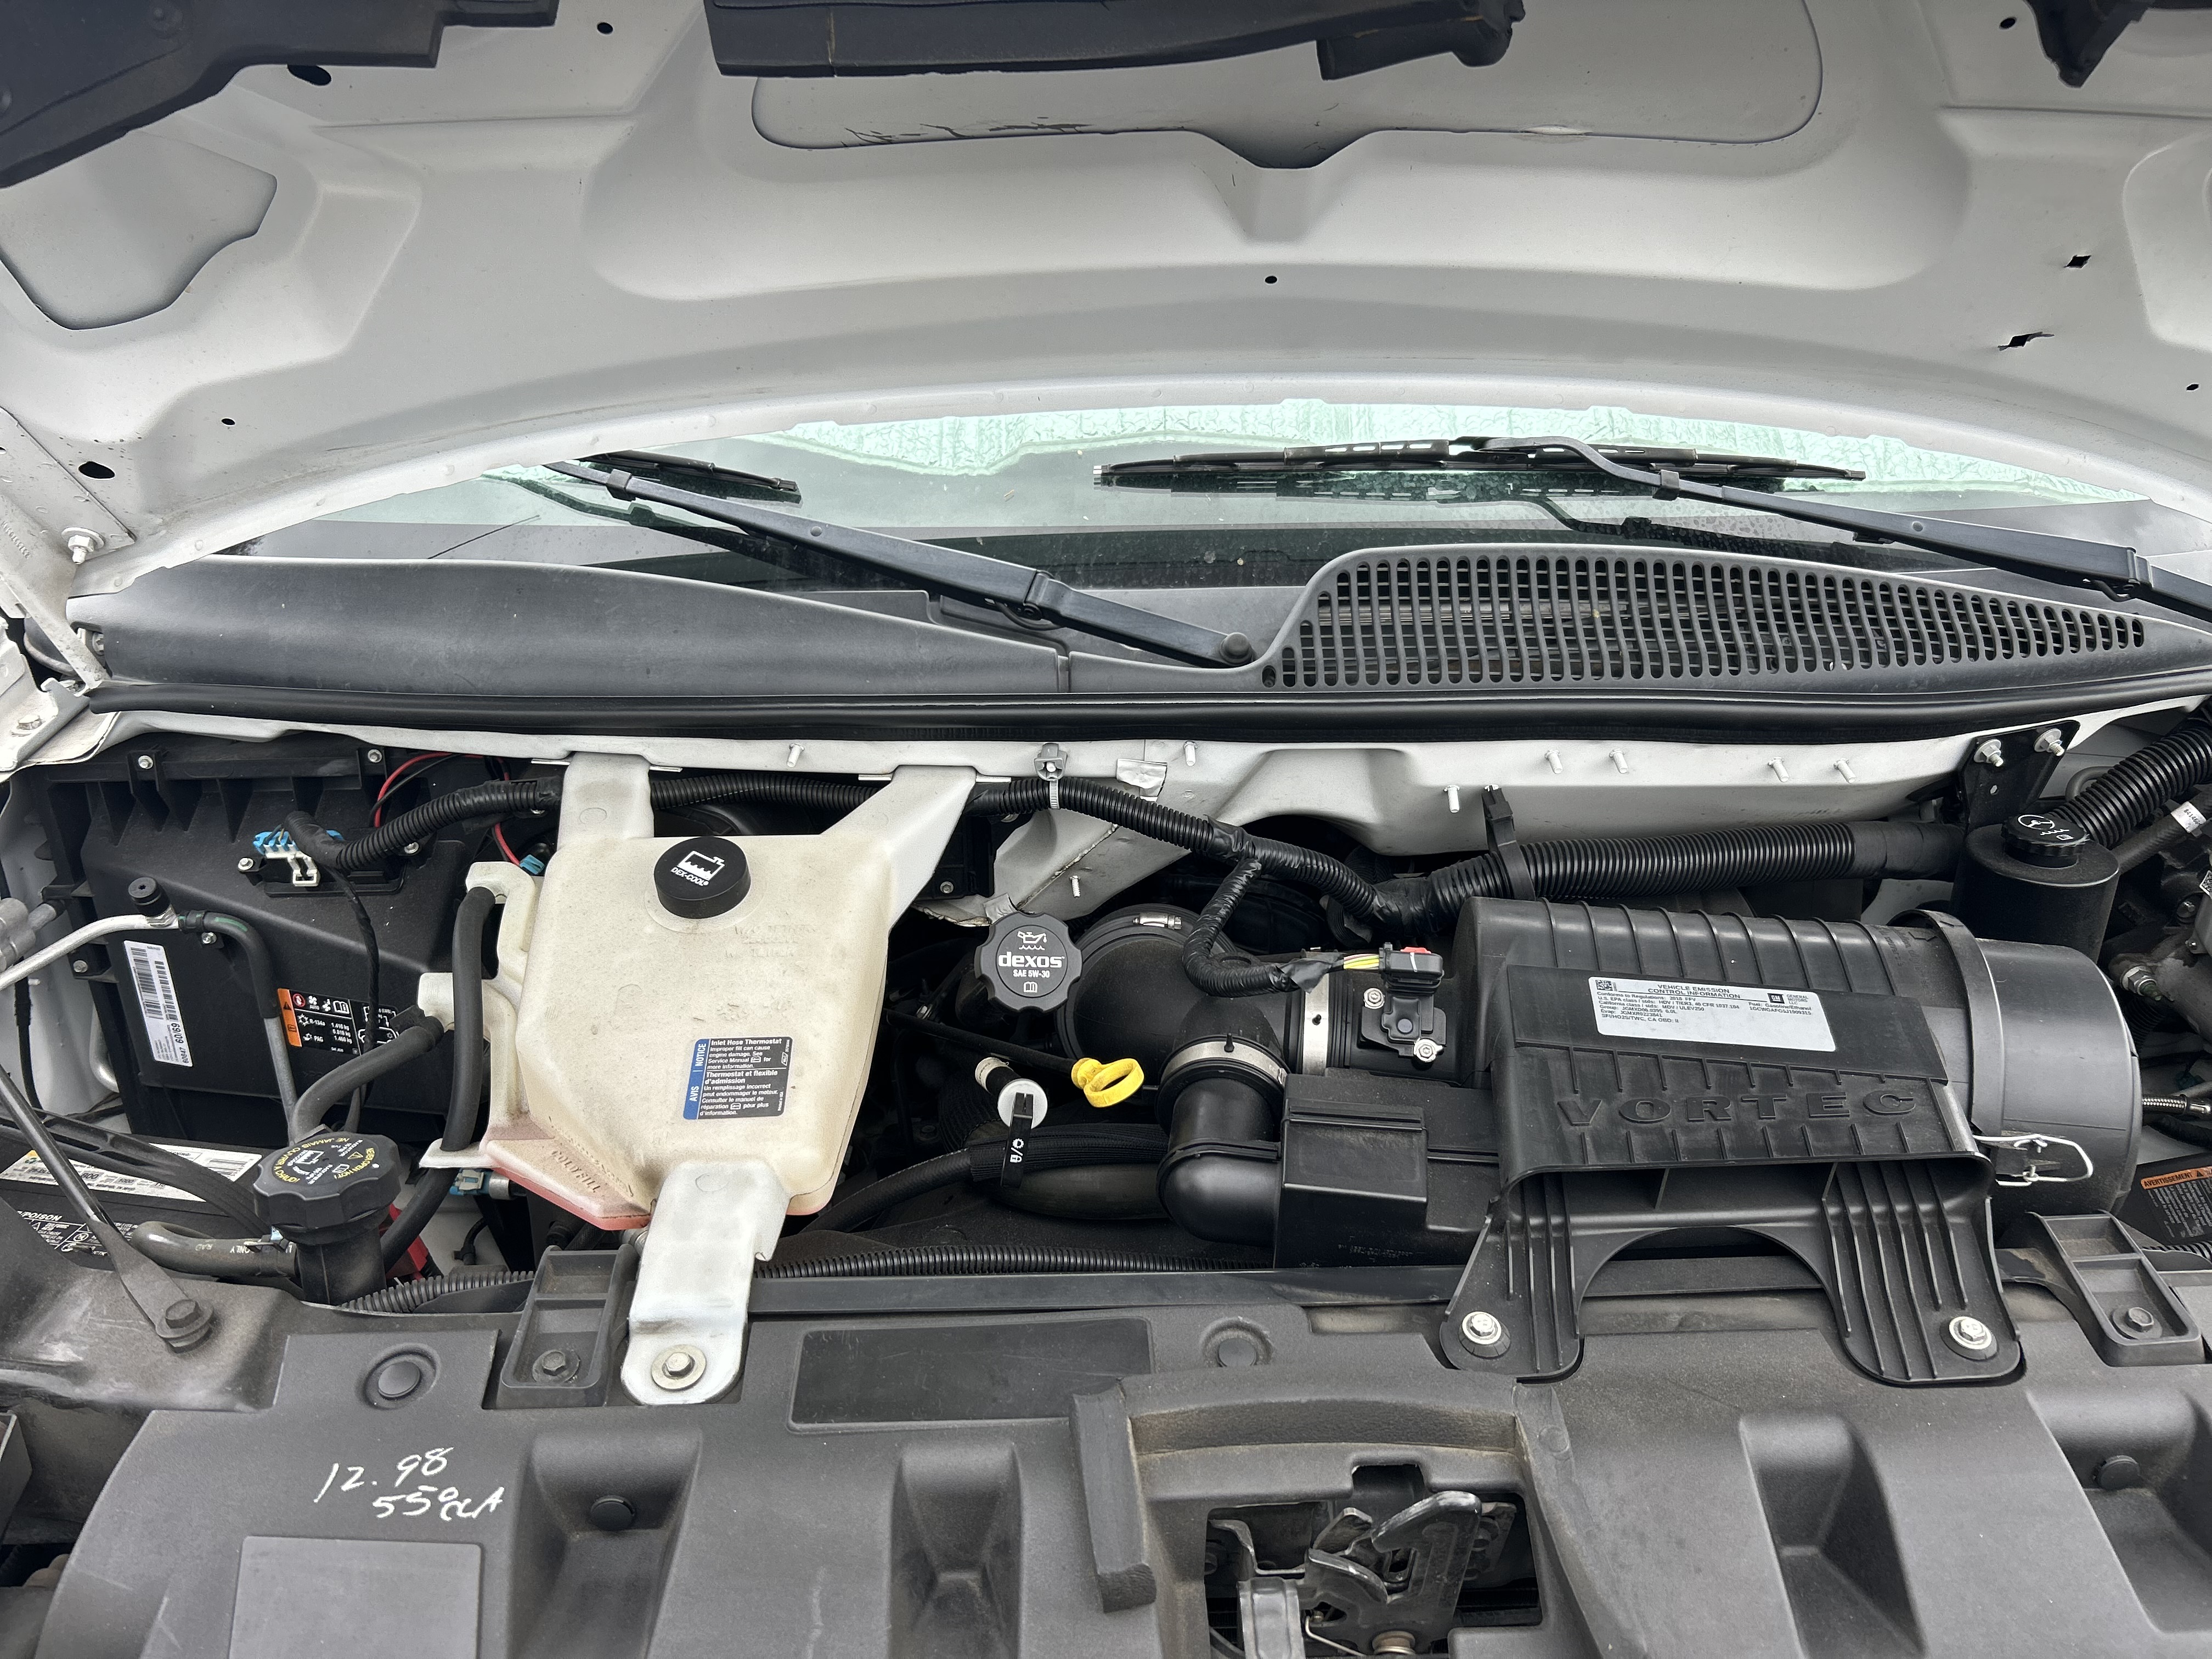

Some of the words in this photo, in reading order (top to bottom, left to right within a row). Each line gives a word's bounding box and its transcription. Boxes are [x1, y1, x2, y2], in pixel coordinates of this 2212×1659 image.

[998, 951, 1064, 968] dexos
[171, 1023, 184, 1043] 60/69
[695, 1043, 707, 1066] NOTICE
[689, 1086, 699, 1102] AVIS
[1557, 1091, 1916, 1126] VORTEC
[302, 1138, 335, 1149] JAMAIS
[576, 1173, 601, 1193] FILL
[2144, 1172, 2193, 1187] AVERTISSEMENT
